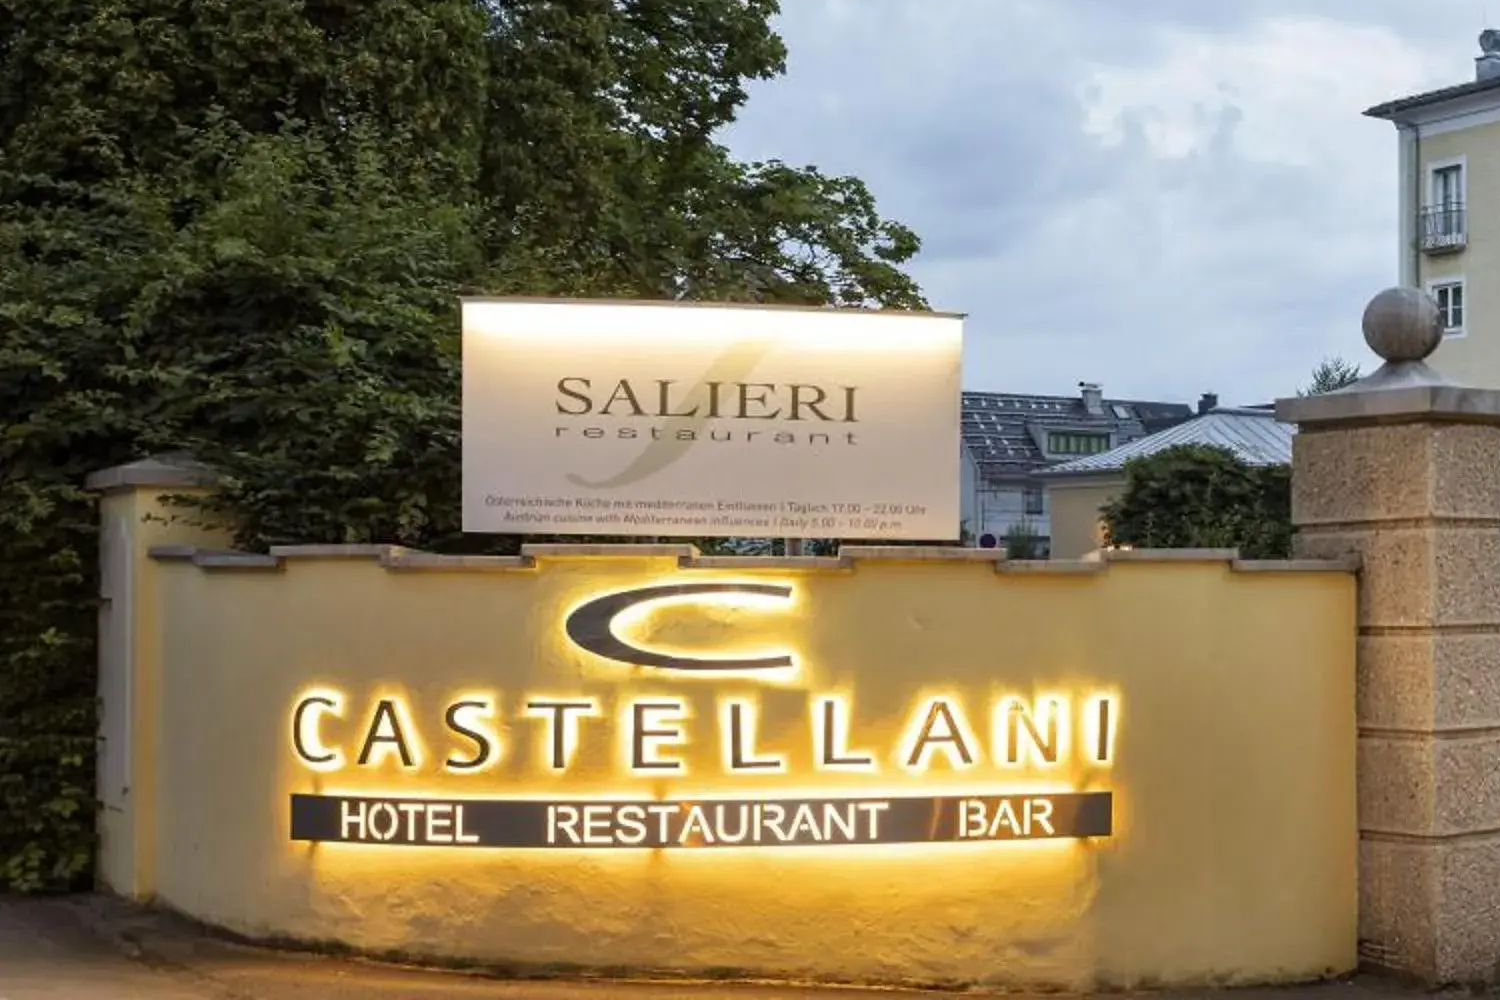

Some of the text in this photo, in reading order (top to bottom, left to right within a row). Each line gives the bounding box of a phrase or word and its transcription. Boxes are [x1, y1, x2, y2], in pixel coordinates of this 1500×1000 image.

[555, 376, 861, 423] SALIERI
[555, 424, 860, 446] restaurant
[293, 697, 1112, 770] CASTELLANI
[340, 798, 1055, 846] HOTEL RESTAURANT BAR
